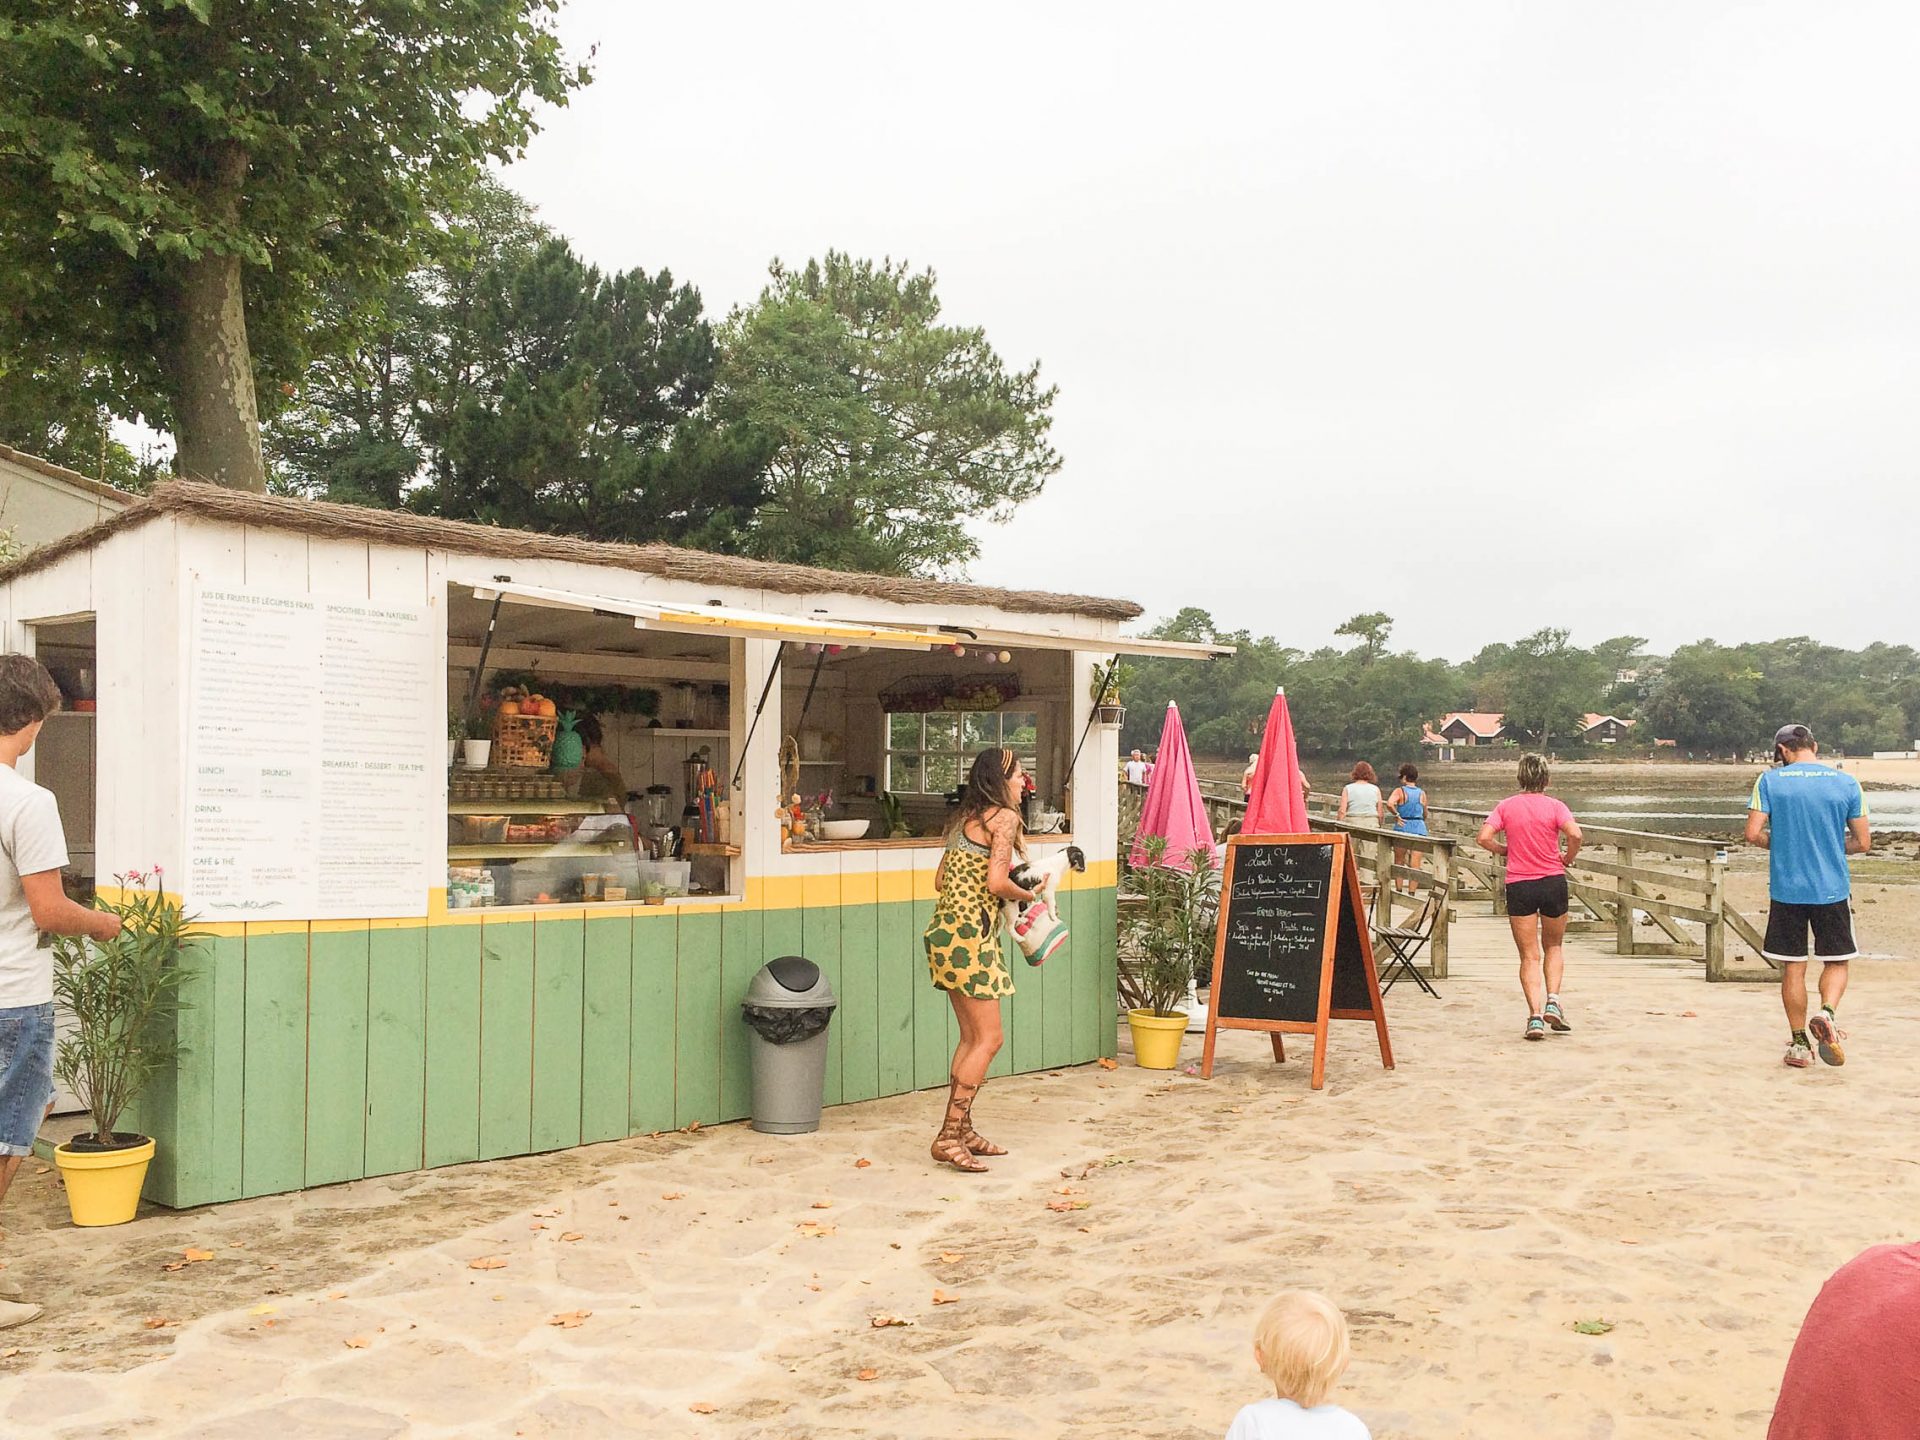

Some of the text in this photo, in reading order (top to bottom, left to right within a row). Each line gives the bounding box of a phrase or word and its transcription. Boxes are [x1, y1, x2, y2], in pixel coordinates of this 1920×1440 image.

[201, 591, 214, 599] JUS
[215, 592, 226, 600] DE
[227, 593, 250, 603] FRUITS
[251, 596, 260, 604] ET
[295, 600, 314, 610] FRAIS
[327, 604, 366, 616] SMOOTHIES
[368, 609, 384, 617] 100%
[386, 611, 418, 621] NATURELS
[198, 766, 224, 774] LUNCH
[321, 760, 358, 769] BREAKFAST
[364, 761, 392, 770] DESSERT
[398, 763, 410, 771] TEA
[411, 764, 424, 772] TIME
[261, 768, 291, 777] BRUNCH
[195, 805, 222, 813] DRINKS
[193, 857, 213, 866] CAFÉ
[222, 857, 235, 866] THÉ
